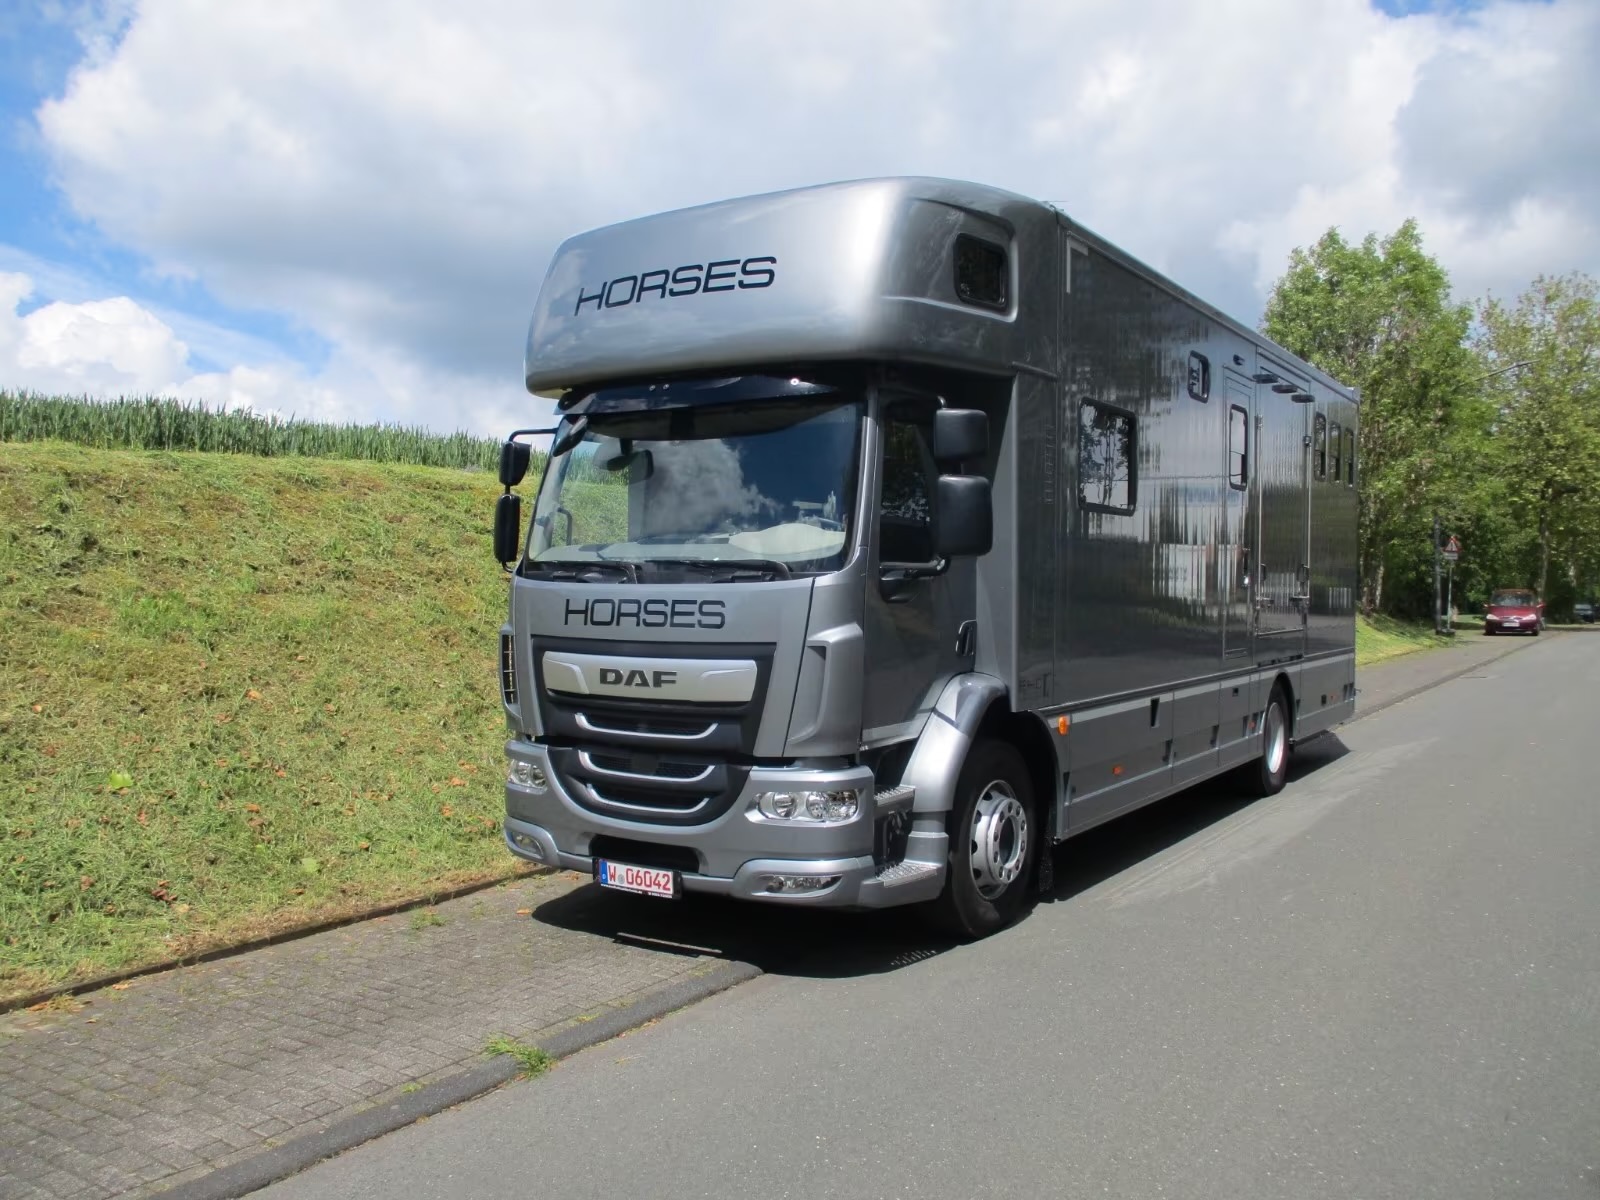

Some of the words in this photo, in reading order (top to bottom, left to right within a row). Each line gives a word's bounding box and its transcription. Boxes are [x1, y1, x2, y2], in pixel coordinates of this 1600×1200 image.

[574, 256, 777, 316] HORSES
[564, 598, 726, 629] HORSES
[600, 668, 677, 688] DAF
[608, 865, 617, 882] W
[625, 868, 671, 891] 06042
